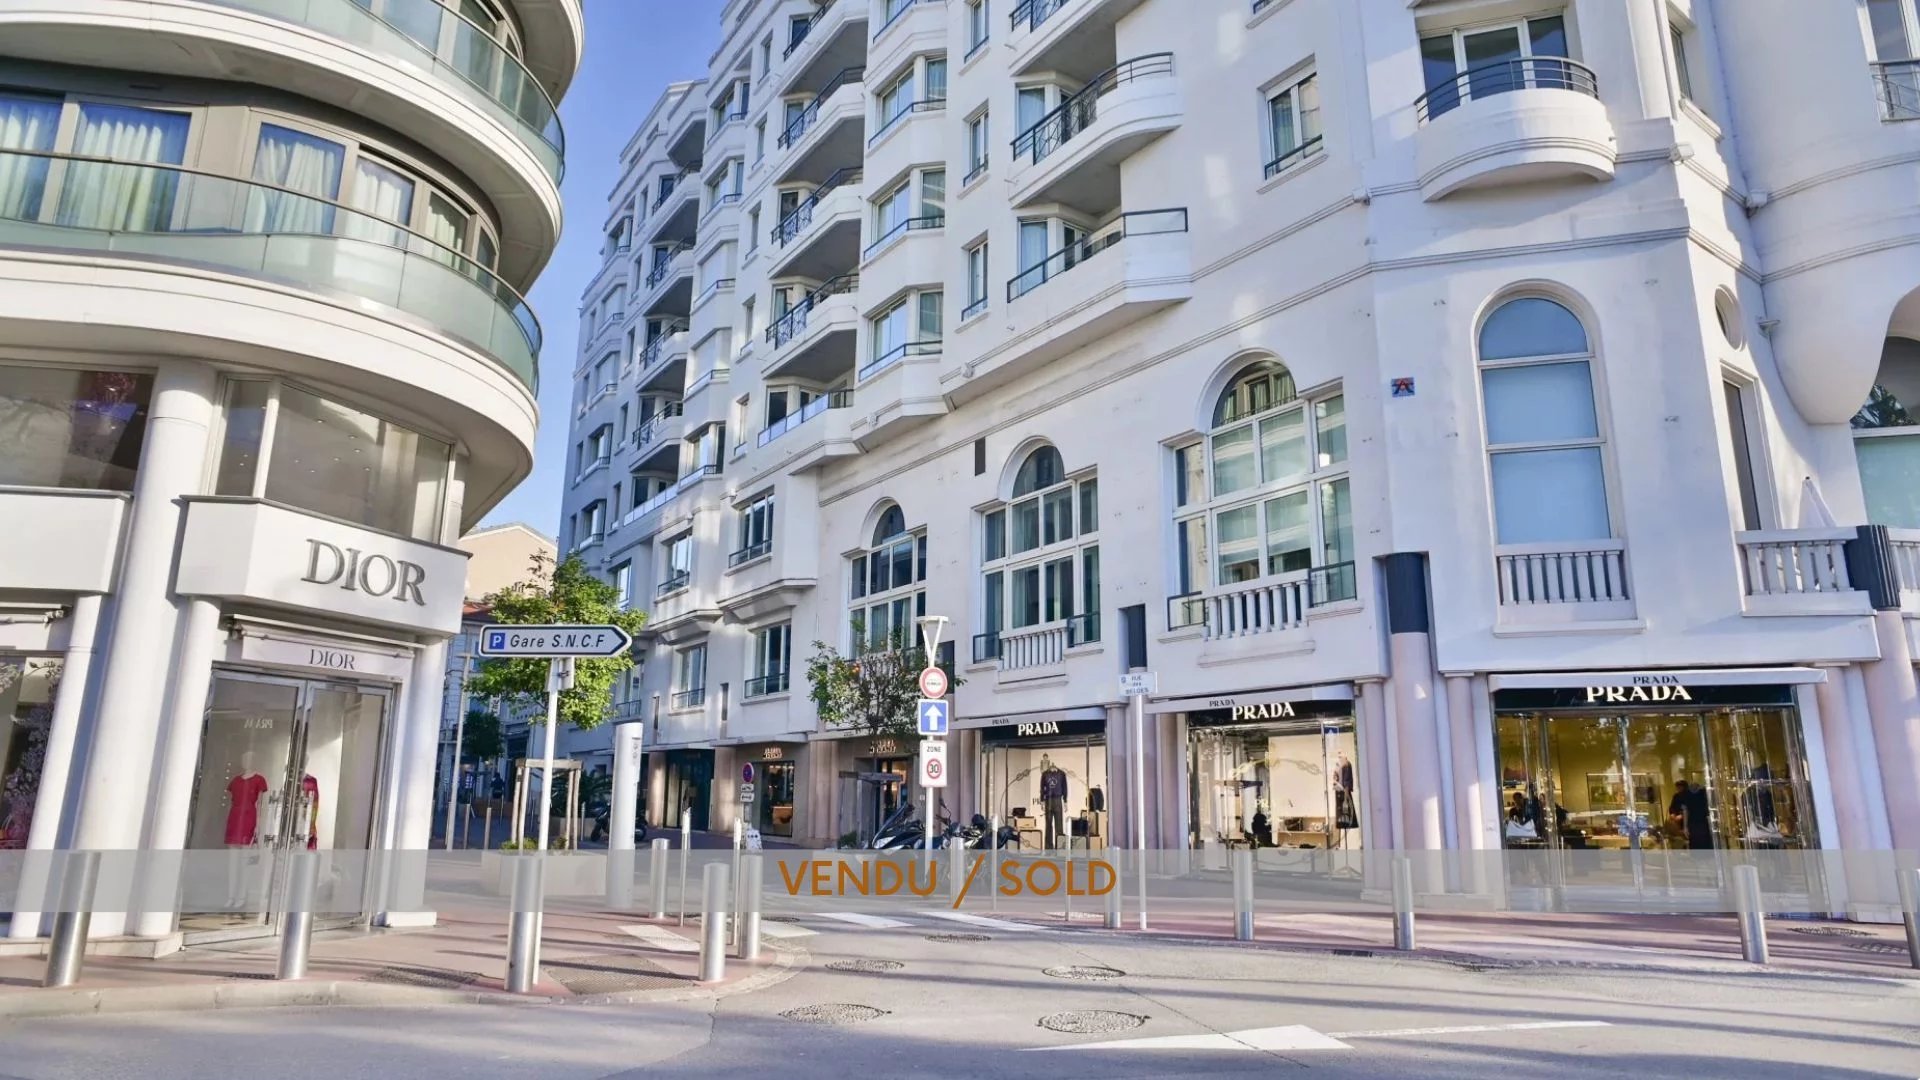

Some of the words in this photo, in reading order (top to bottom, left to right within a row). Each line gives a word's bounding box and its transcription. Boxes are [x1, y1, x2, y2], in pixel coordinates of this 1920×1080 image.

[300, 538, 426, 606] DIOR
[491, 635, 502, 647] P
[510, 634, 545, 648] Gare
[552, 634, 605, 648] S.N.C.F
[309, 648, 356, 670] DIOR
[1632, 675, 1679, 685] PRADA
[1586, 685, 1692, 702] PRADA
[1209, 699, 1236, 707] PRADA
[1232, 702, 1295, 721] PRADA
[992, 718, 1009, 726] PRADA
[1018, 721, 1059, 736] PRADA
[929, 763, 939, 774] 30
